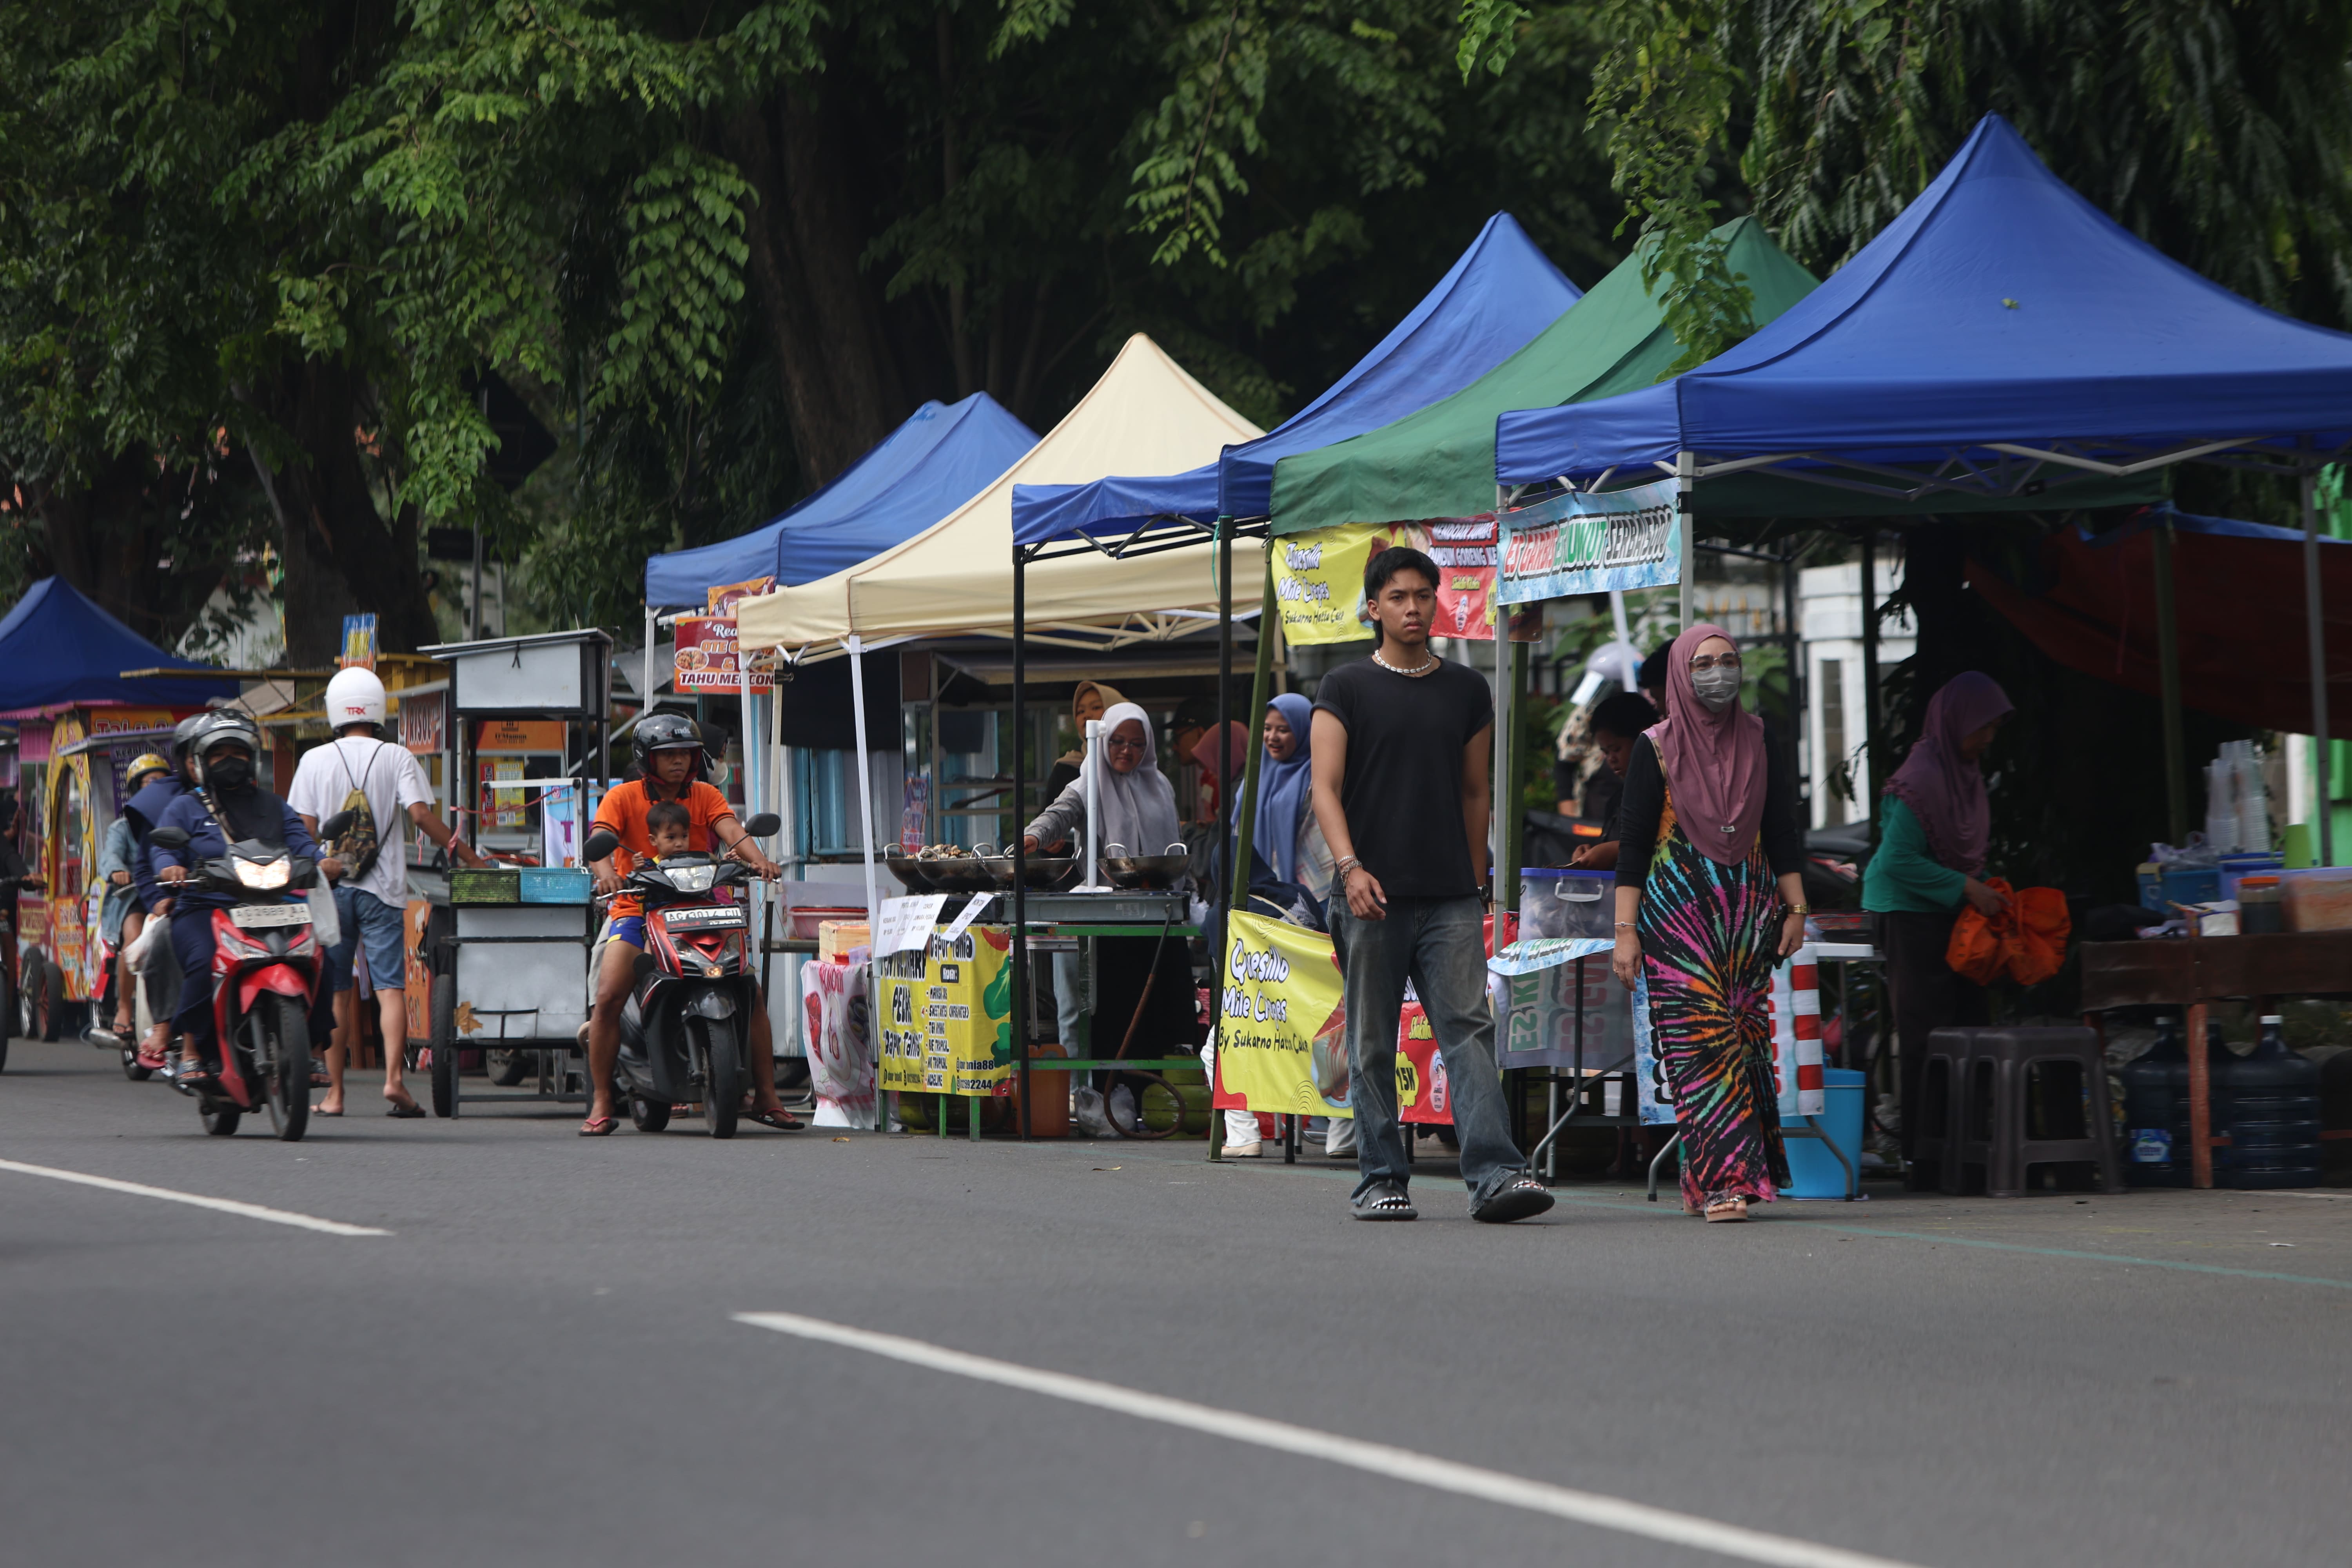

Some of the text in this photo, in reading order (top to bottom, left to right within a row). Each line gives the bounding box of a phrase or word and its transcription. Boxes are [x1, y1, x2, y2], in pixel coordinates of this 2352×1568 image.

[1455, 545, 1487, 566] GORENG
[1276, 576, 1330, 608] Mile Crepes
[1286, 610, 1312, 624] Sukarno
[702, 641, 728, 653] OTE
[680, 673, 773, 684] TAHU MECON
[1230, 938, 1290, 986] Quesillo
[1220, 985, 1251, 1019] Mile
[1219, 1026, 1230, 1054] By
[1233, 1029, 1272, 1050] Sukarno
